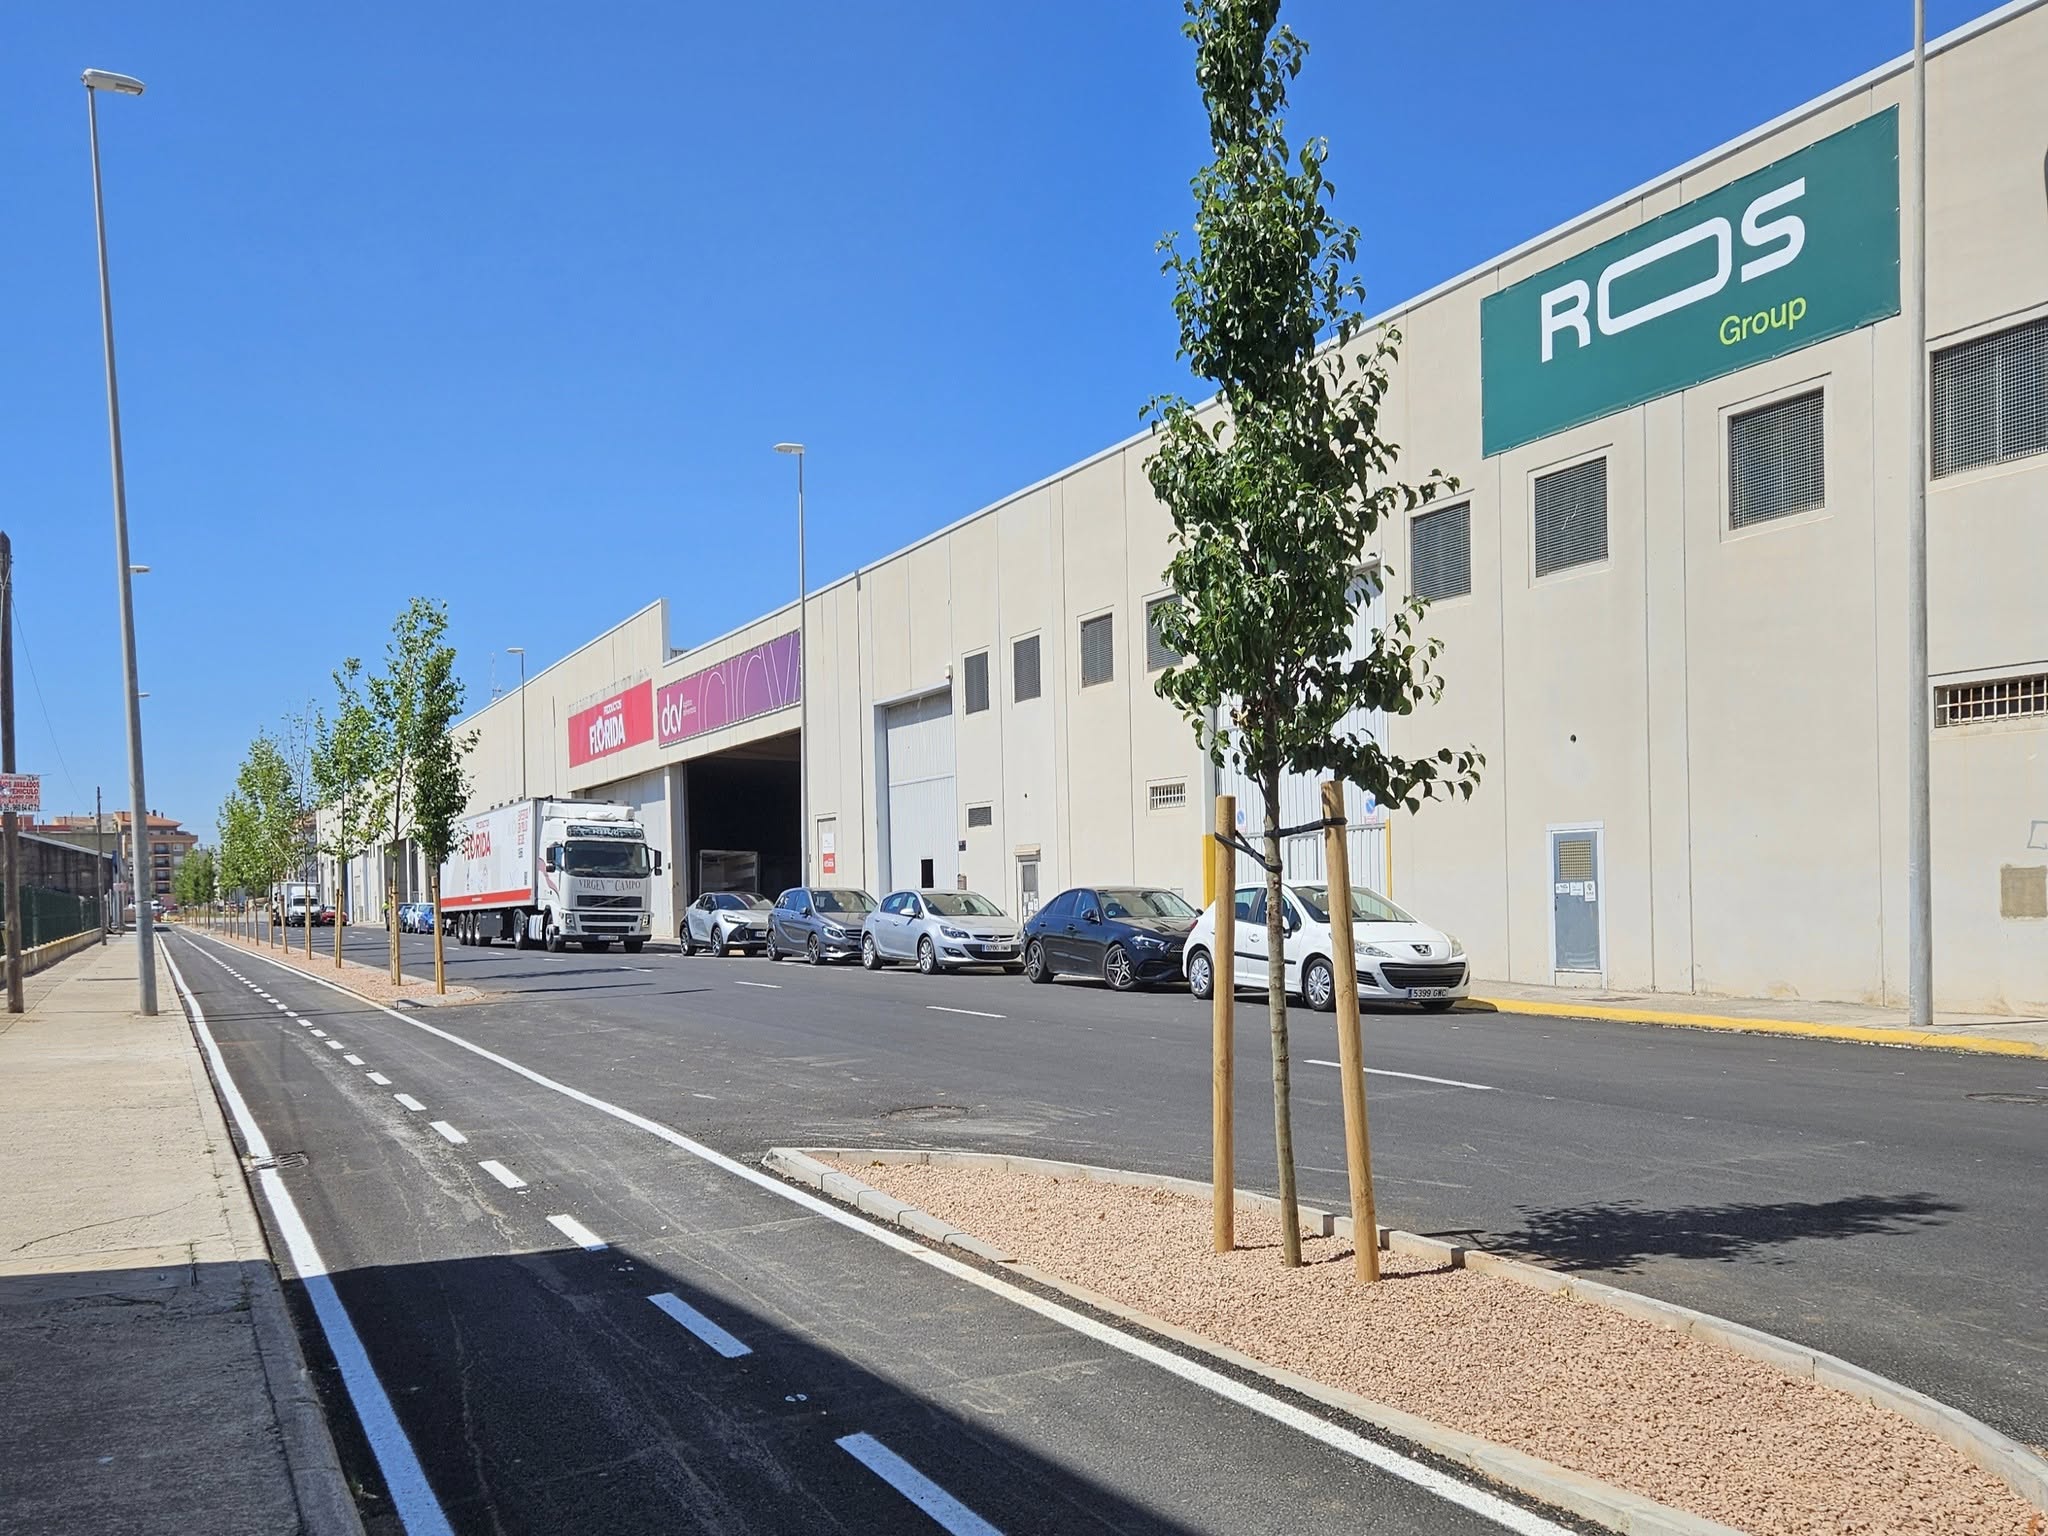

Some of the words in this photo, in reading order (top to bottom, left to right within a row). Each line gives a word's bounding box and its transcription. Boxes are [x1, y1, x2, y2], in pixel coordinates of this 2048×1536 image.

[1541, 176, 1805, 363] ROS
[1719, 297, 1807, 345] Group
[589, 714, 625, 755] FLORIDA
[662, 693, 684, 736] dcv
[579, 879, 605, 891] VIRGEN
[615, 880, 641, 891] CAMPO
